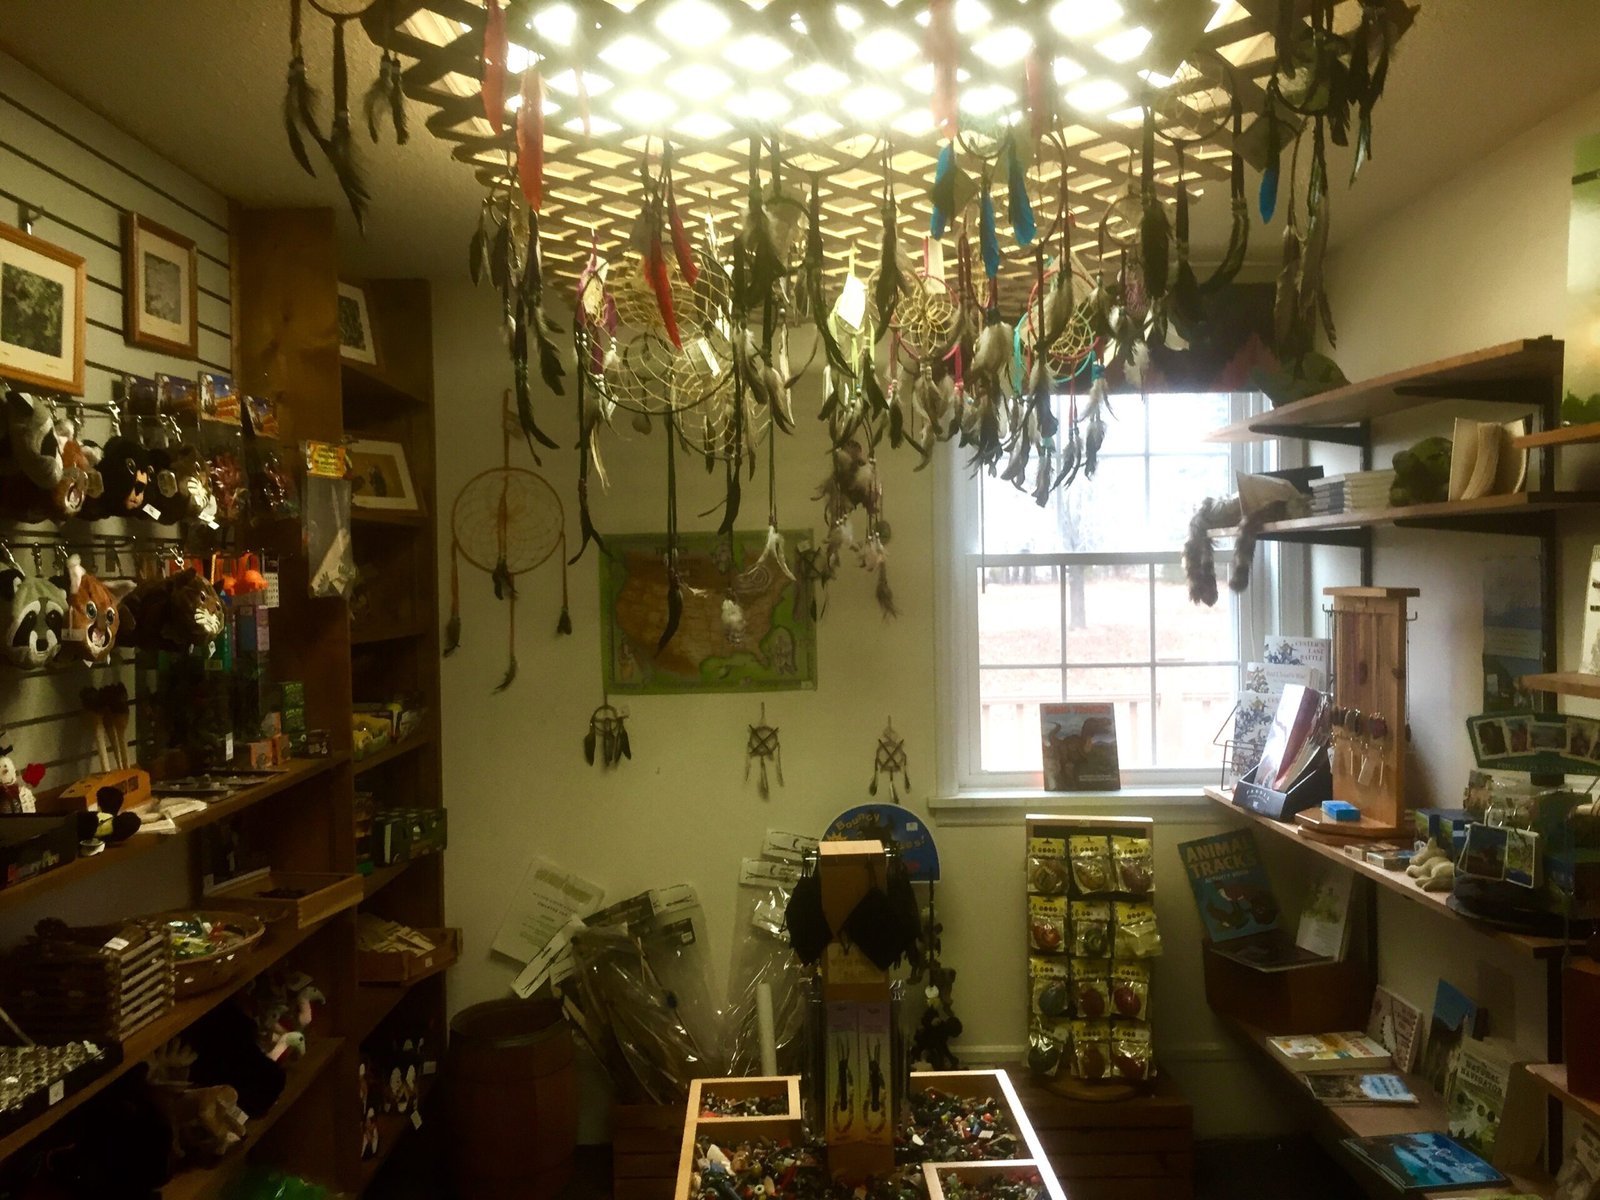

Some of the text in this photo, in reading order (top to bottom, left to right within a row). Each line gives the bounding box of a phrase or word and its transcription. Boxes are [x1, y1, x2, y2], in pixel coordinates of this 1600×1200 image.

[836, 811, 880, 832] Bouncy
[1186, 837, 1248, 863] ANIMAL
[1188, 854, 1257, 879] TRACKS
[1460, 1067, 1503, 1097] NAVIGATOR
